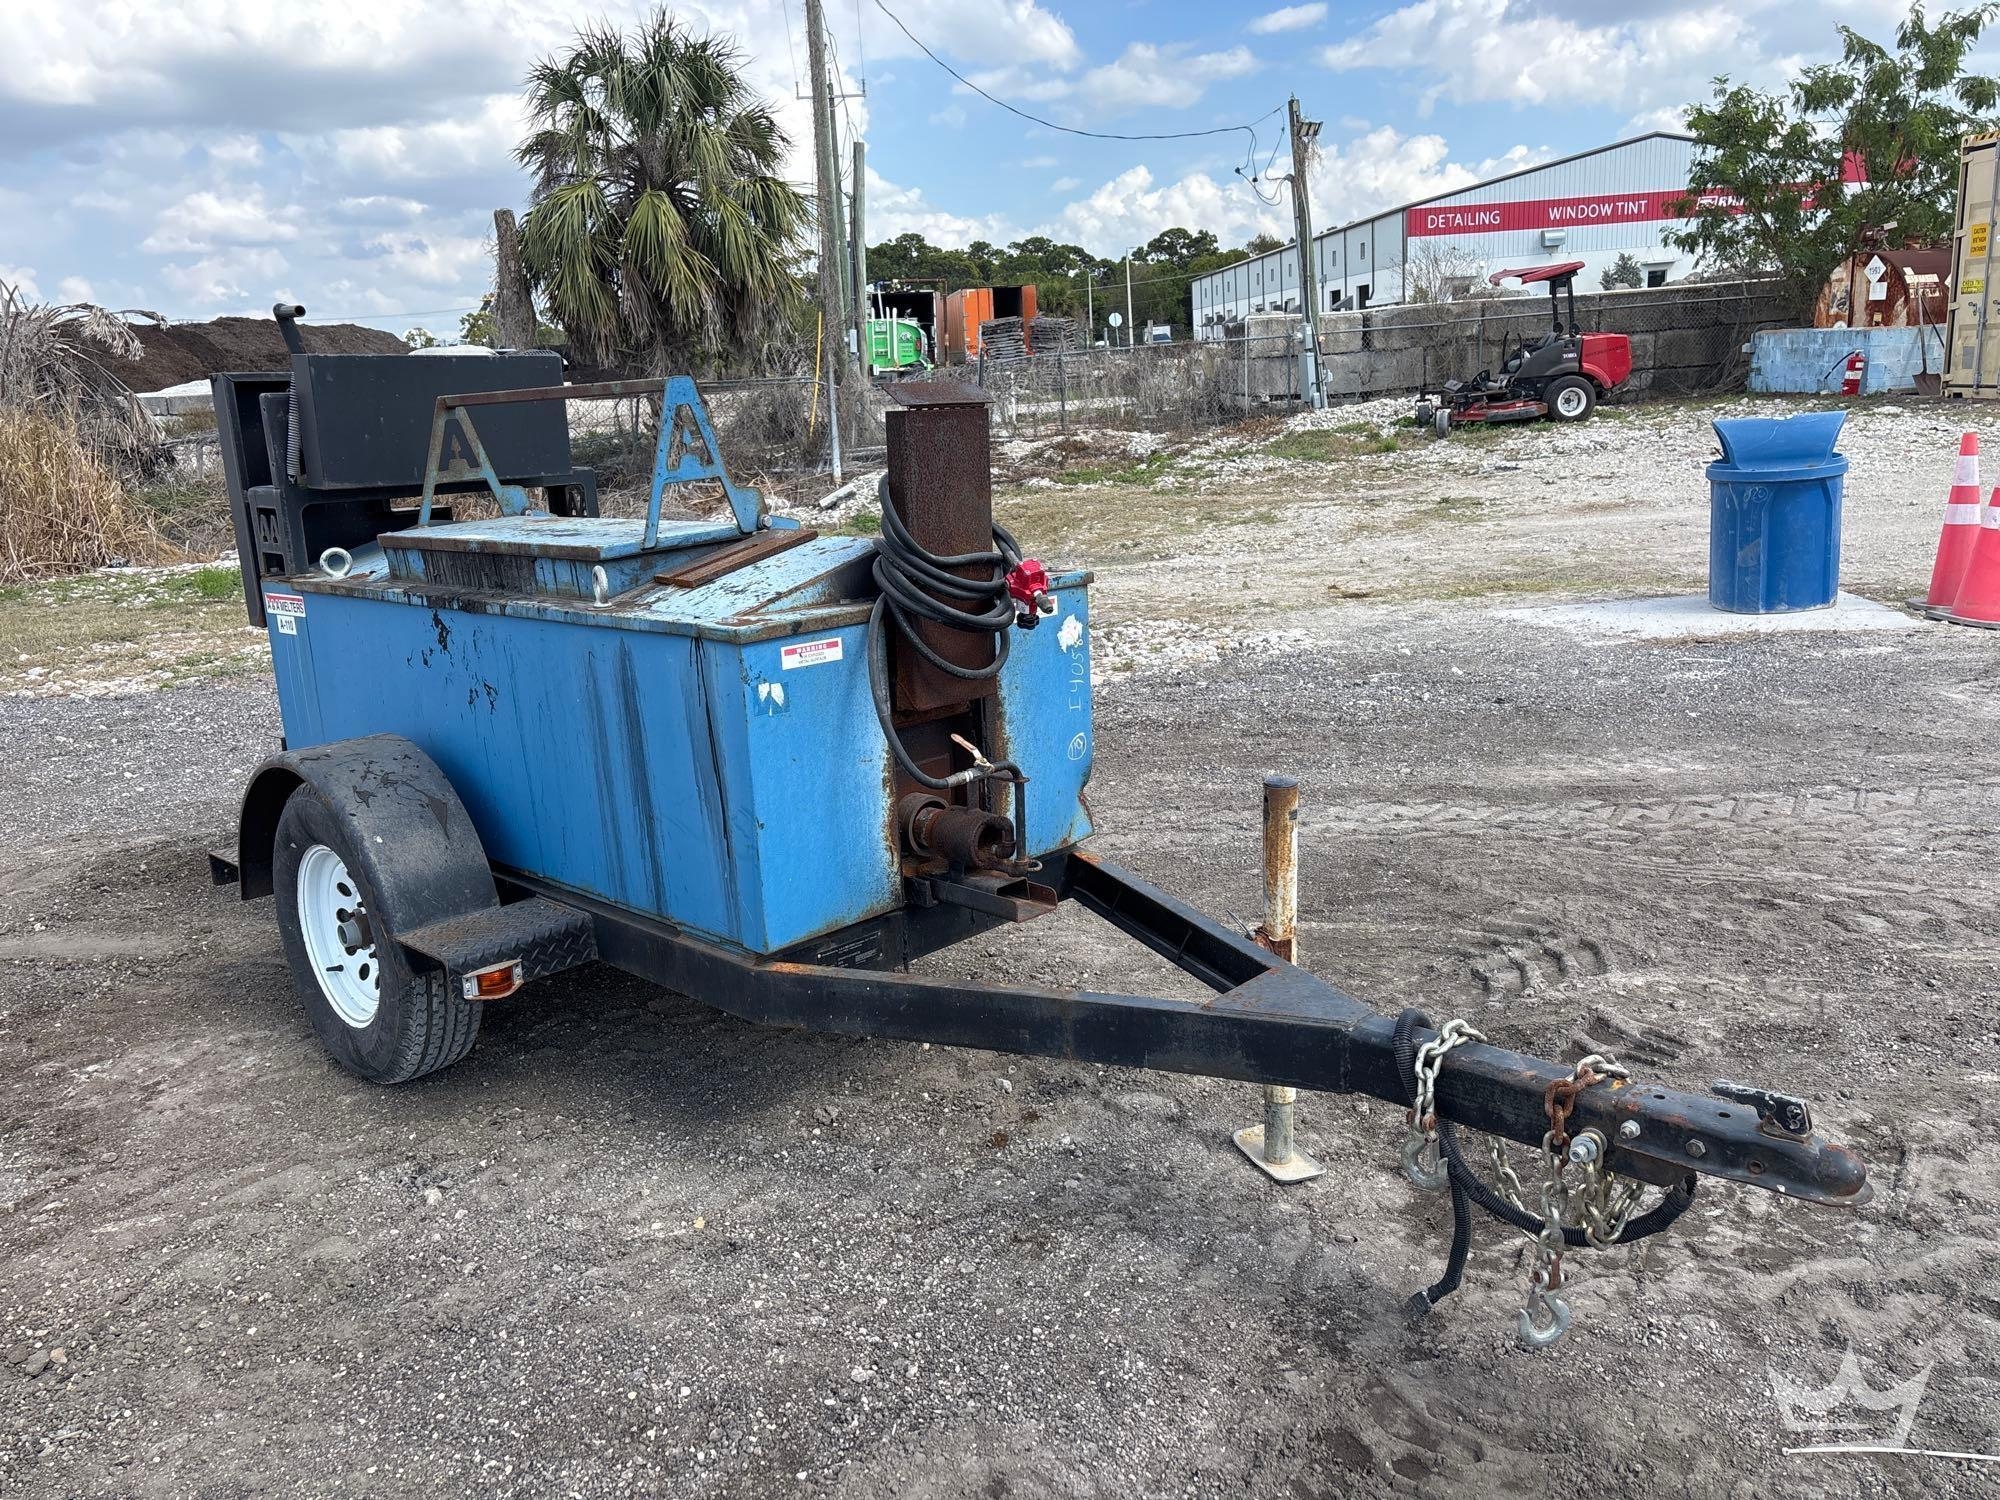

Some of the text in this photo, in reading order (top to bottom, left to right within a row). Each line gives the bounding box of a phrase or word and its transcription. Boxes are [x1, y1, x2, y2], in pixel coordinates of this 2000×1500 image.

[1549, 200, 1648, 220] WINDOW TINT
[1427, 211, 1500, 229] DETAILING
[796, 644, 828, 654] WARNING
